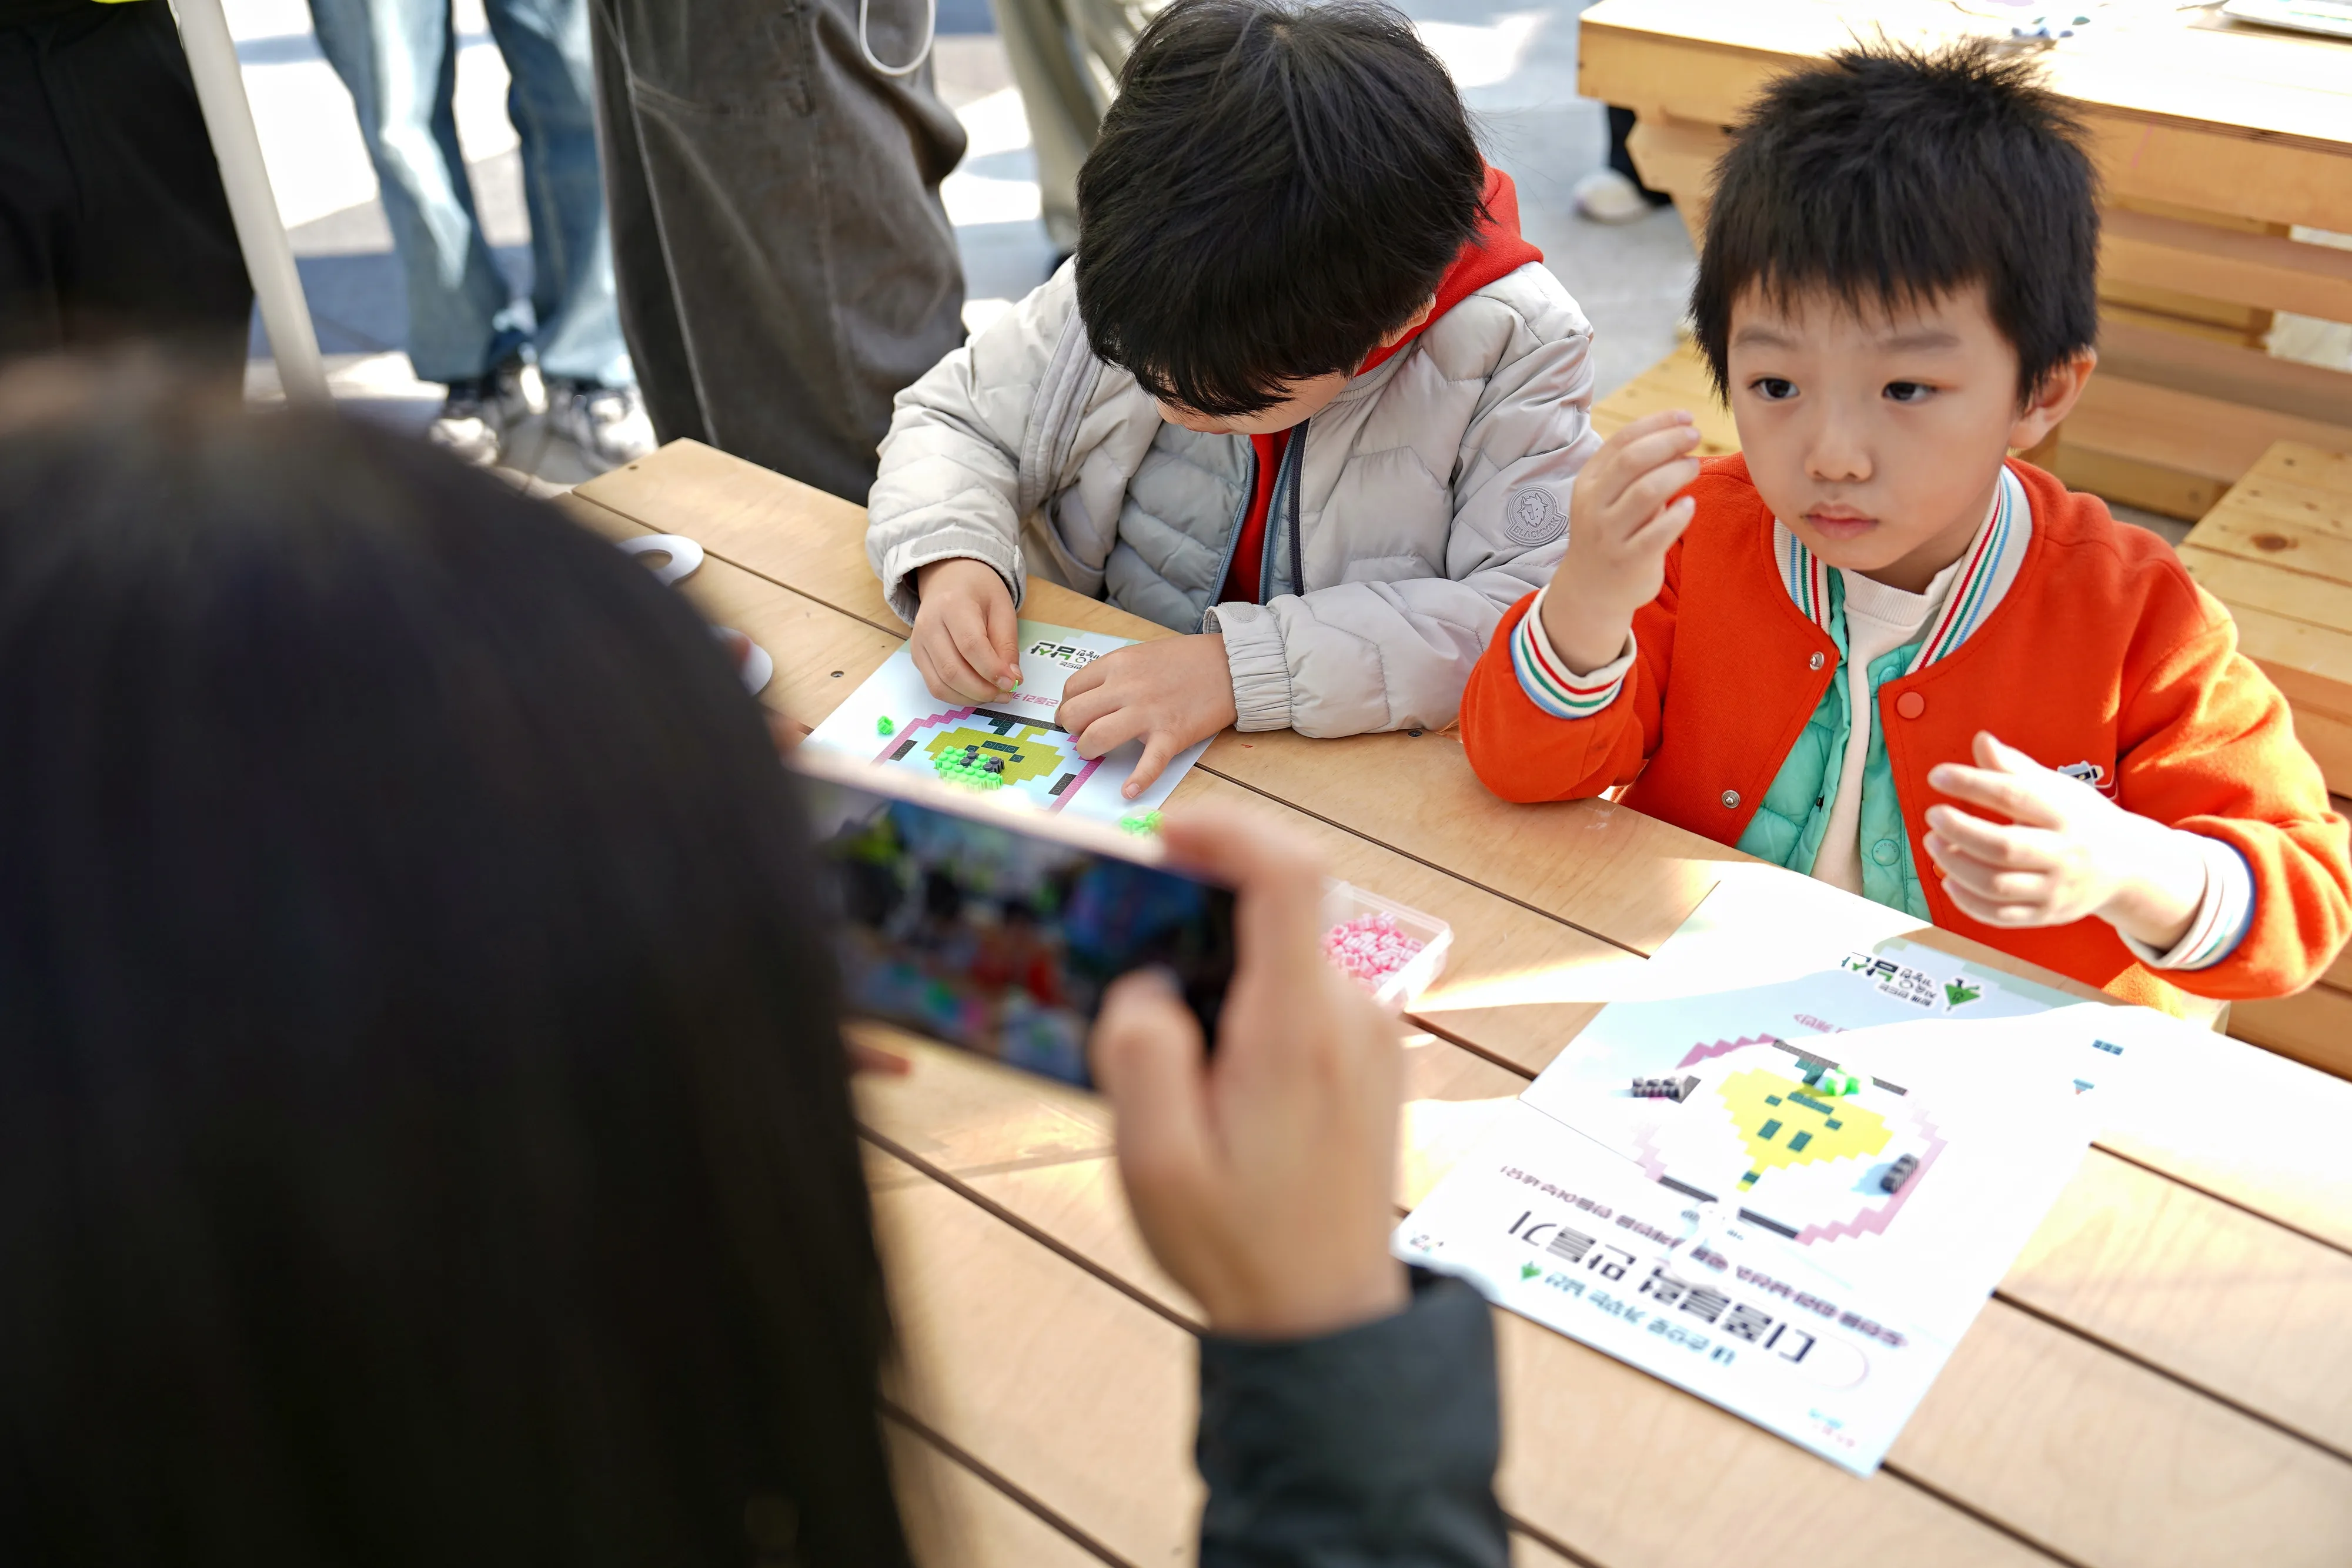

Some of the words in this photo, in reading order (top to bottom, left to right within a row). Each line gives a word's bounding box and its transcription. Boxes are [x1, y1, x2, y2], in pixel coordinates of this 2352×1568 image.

[1514, 517, 1560, 538] BLACKYAK
[1030, 642, 1076, 660] 남산
[1059, 661, 1083, 670] 만드는
[1022, 694, 1060, 707] 곤돌라
[1875, 842, 1897, 853] BLUEDOG
[1841, 952, 1899, 982] 남산
[1508, 1211, 1637, 1282] 만들기
